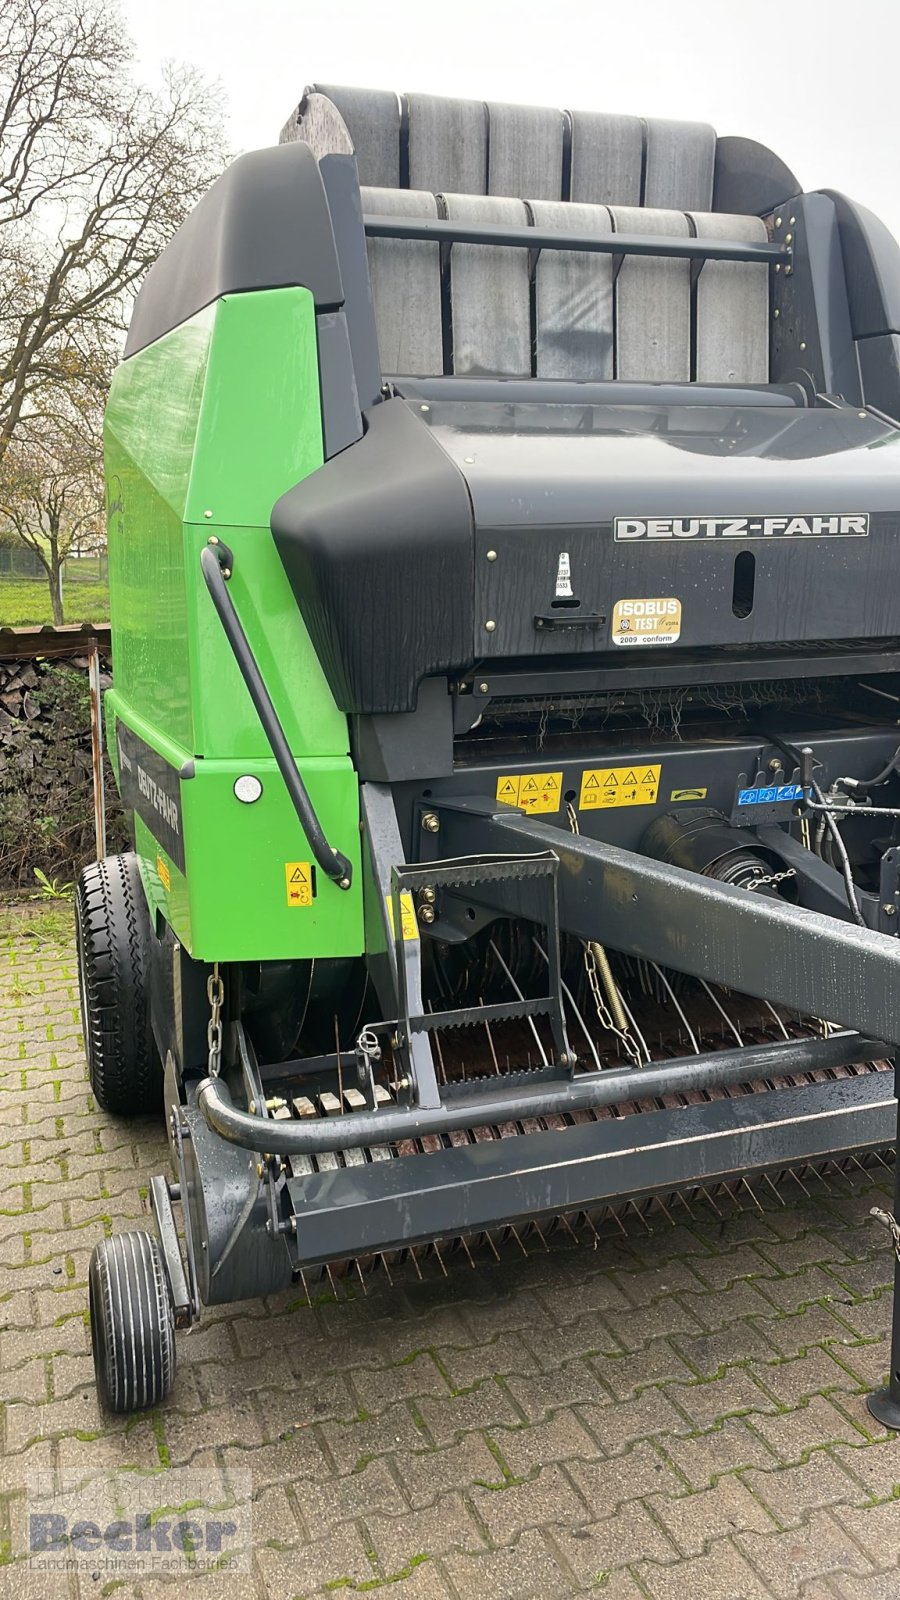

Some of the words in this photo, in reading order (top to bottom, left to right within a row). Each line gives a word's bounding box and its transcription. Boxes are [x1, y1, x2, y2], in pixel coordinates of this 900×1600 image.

[617, 517, 867, 539] DEUTZ-FAHR
[618, 601, 677, 616] ISOBUS
[635, 618, 659, 630] TEST
[620, 636, 638, 644] 2009
[642, 635, 672, 643] conform
[137, 765, 179, 835] DEUTZ-FAHR
